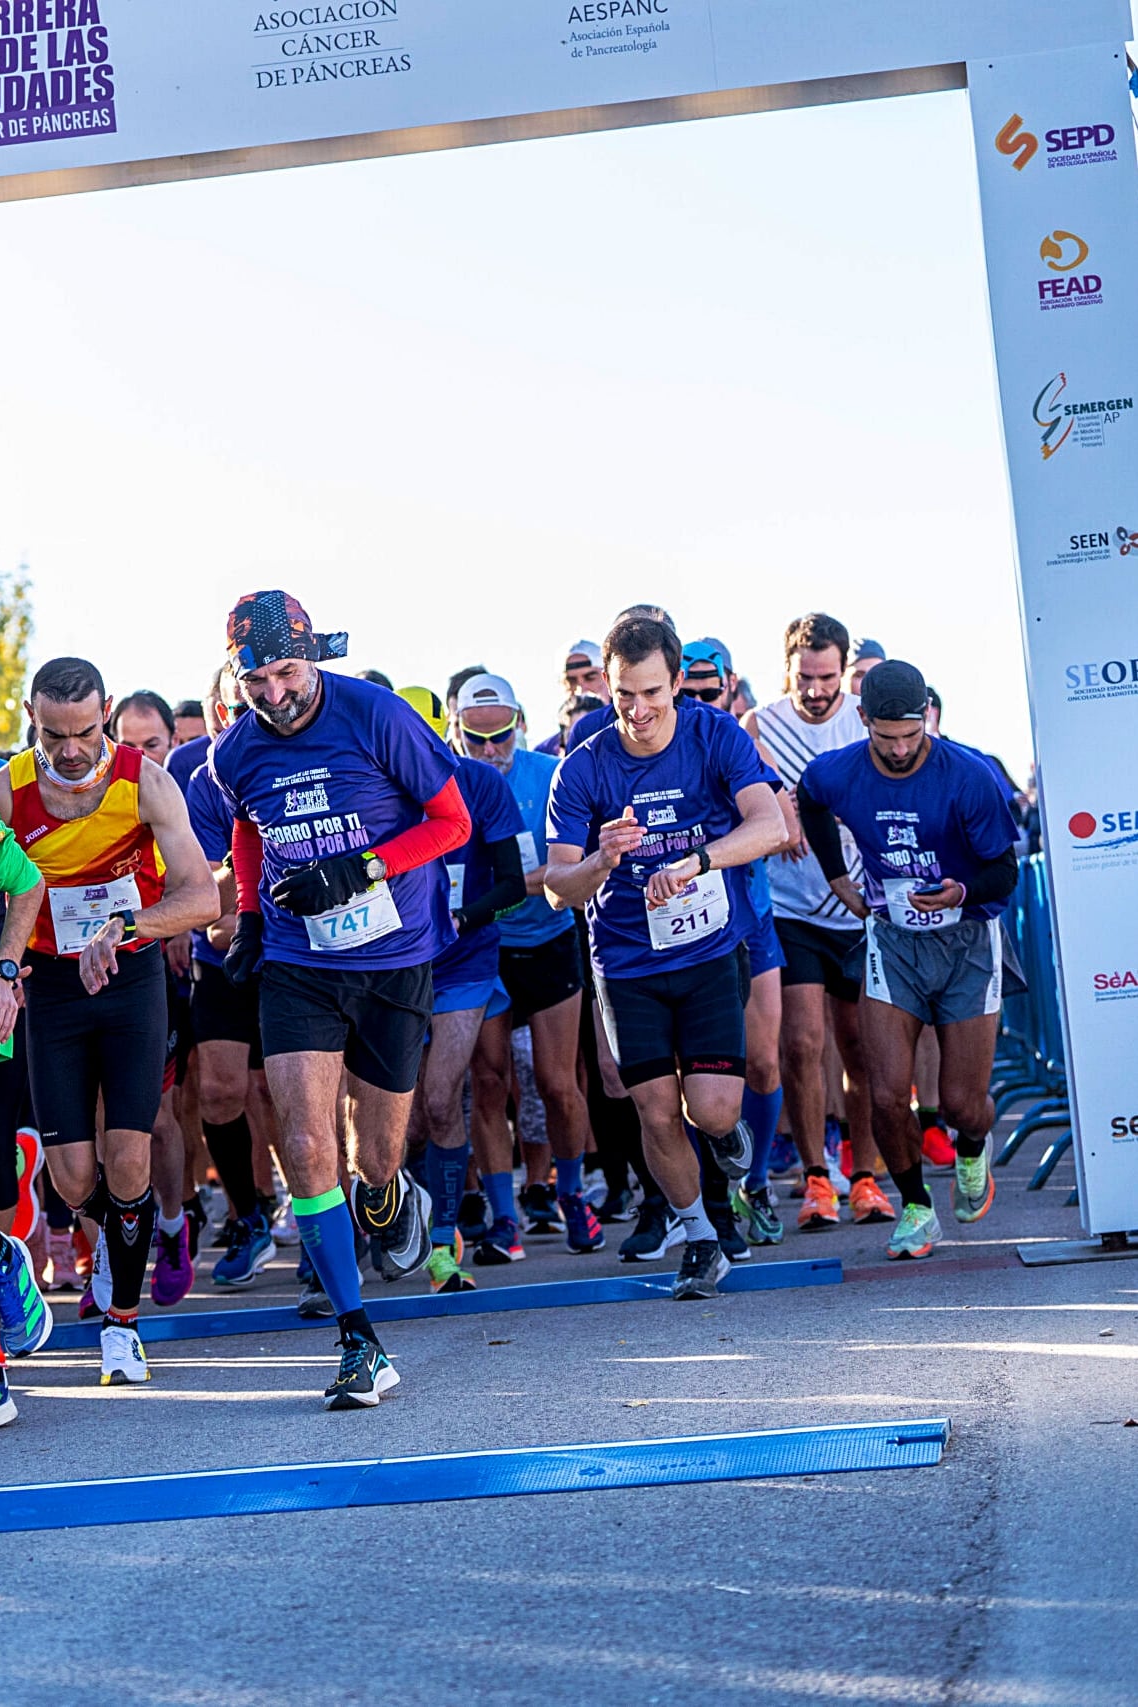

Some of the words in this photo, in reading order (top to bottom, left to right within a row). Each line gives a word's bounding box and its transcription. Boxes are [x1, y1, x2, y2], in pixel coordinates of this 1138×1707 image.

[570, 27, 622, 42] Asociación
[626, 20, 670, 37] Española
[47, 25, 109, 69] LAS
[282, 29, 381, 57] CÁNCER
[571, 47, 583, 58] de
[585, 39, 657, 56] Pancreatología
[256, 69, 287, 88] DE
[292, 54, 411, 85] PÁNCREAS
[9, 118, 28, 137] DE
[33, 107, 111, 135] PÁNCREAS
[1044, 124, 1115, 152] SEPD
[1038, 275, 1102, 299] FEAD
[1064, 397, 1133, 416] SEMERGEN
[1103, 411, 1121, 425] AP
[1070, 532, 1109, 550] SEEN
[267, 822, 312, 844] CORRO
[313, 817, 344, 837] POR
[344, 813, 361, 831] TI
[692, 824, 703, 837] TI
[315, 834, 346, 857] POR
[666, 836, 689, 852] POR
[323, 906, 370, 938] 747
[670, 909, 709, 935] 211
[904, 909, 944, 926] 295
